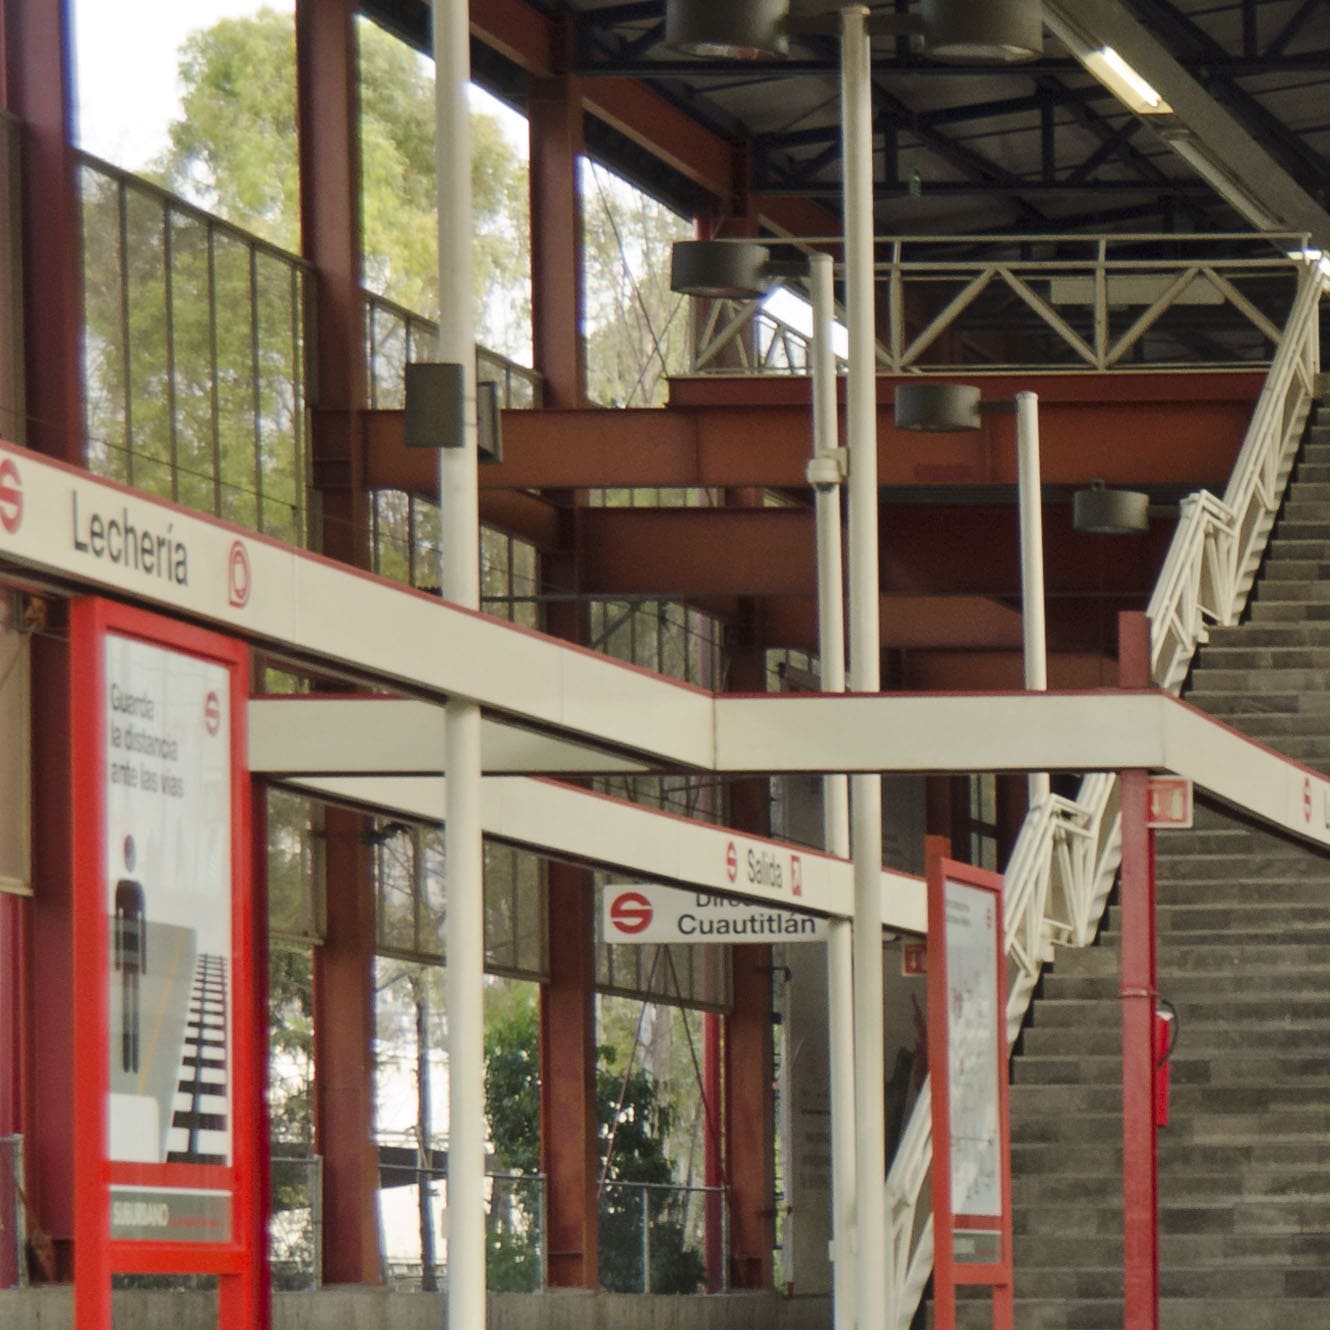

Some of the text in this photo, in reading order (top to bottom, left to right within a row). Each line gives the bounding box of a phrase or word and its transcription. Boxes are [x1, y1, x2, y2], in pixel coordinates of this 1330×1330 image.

[72, 489, 188, 586] Lechería
[747, 848, 783, 889] Salida
[677, 912, 816, 935] Cuautitlán
